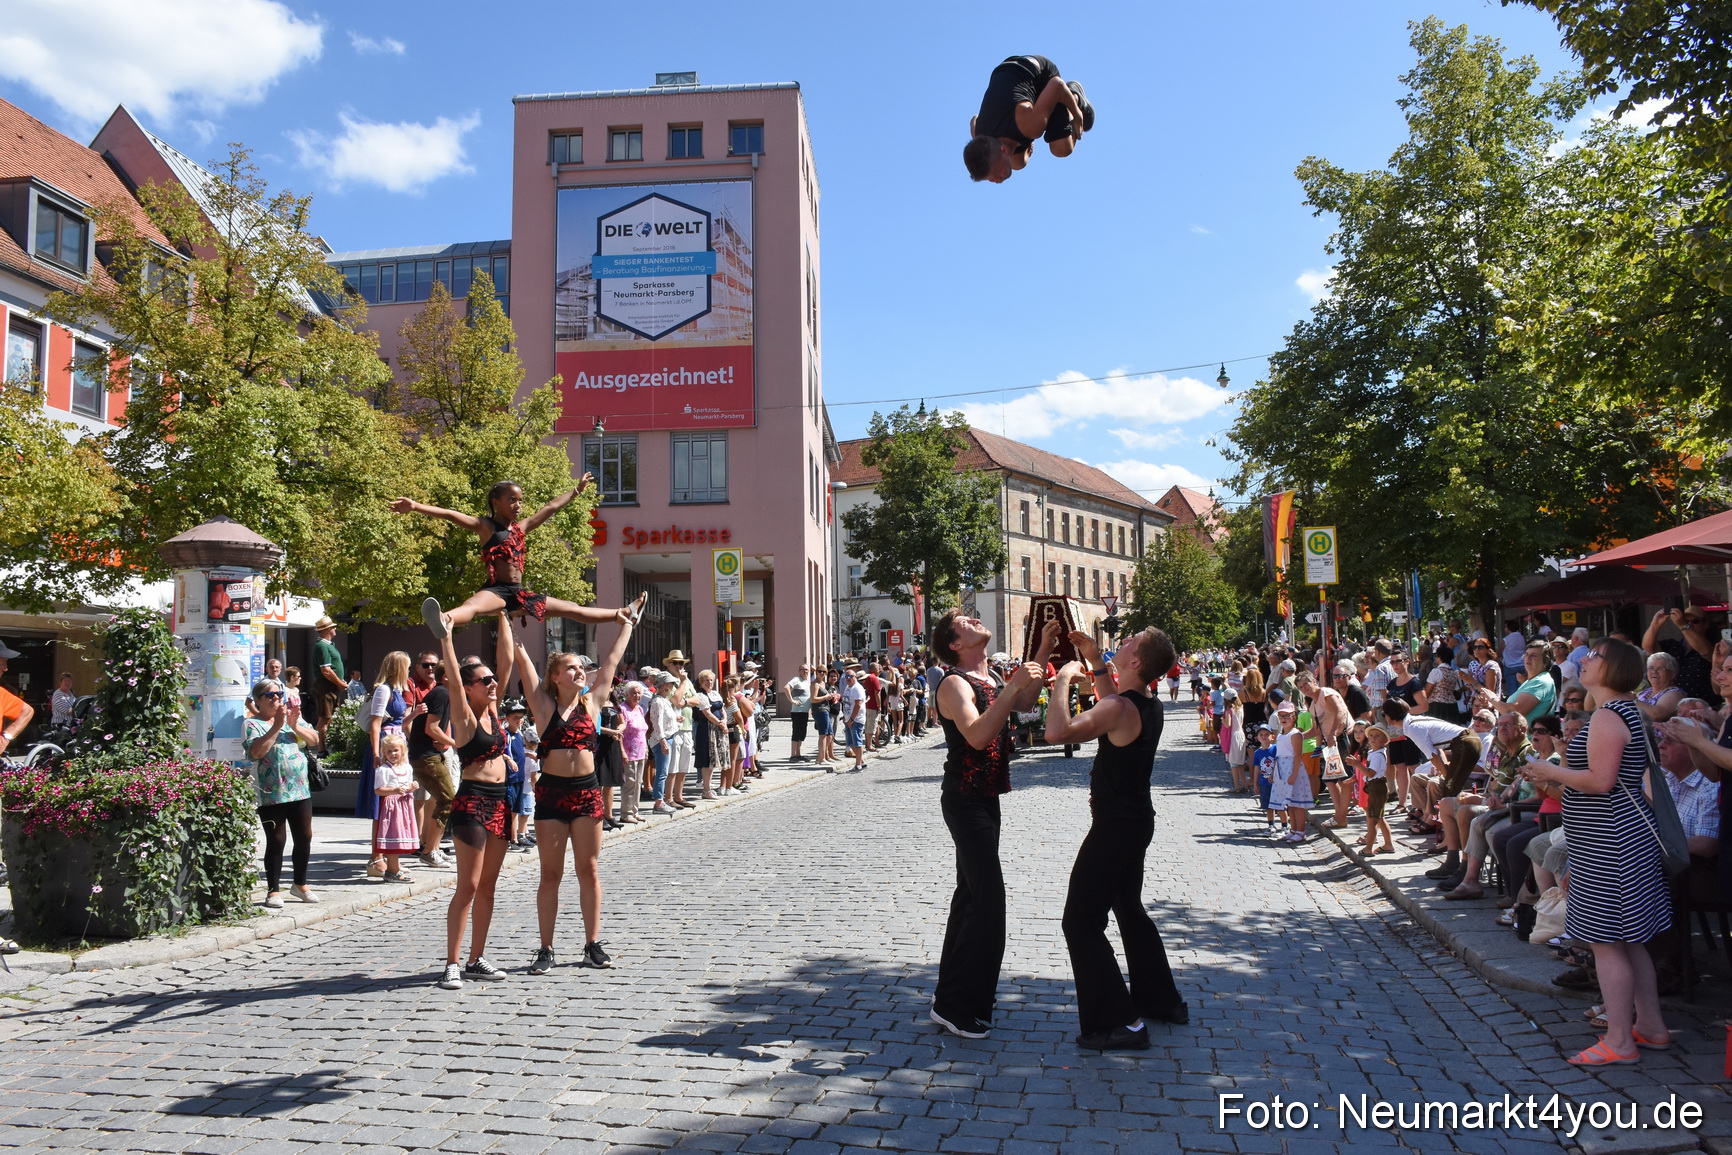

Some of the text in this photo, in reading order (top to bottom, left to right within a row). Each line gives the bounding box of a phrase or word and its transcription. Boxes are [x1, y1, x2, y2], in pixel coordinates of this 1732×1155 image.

[605, 224, 633, 238] DIE
[644, 256, 694, 264] BANKENTEST
[602, 265, 706, 275] Beratung Baufinanzierung
[632, 282, 675, 290] Sparkasse
[614, 289, 694, 298] Neumarkt-Parsberg
[574, 366, 734, 392] Ausgezeichnet!
[622, 524, 731, 550] Sparkasse
